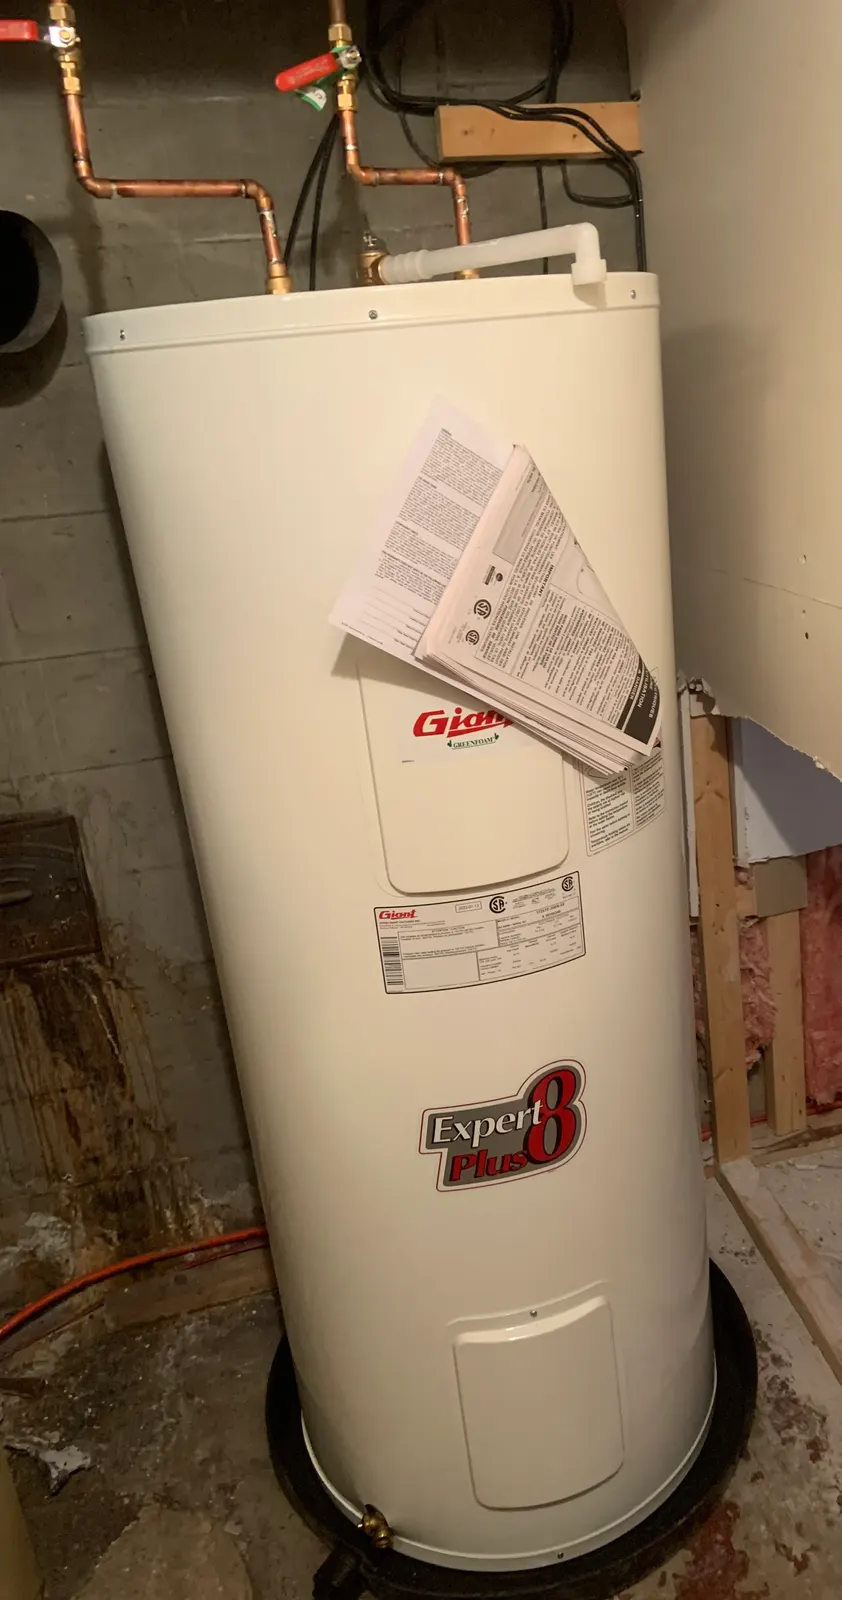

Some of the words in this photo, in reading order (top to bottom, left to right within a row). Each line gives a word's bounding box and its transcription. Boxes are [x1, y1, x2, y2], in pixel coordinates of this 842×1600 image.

[537, 564, 554, 596] IMPORTANT
[413, 707, 513, 738] Gian
[379, 910, 418, 920] Giant
[432, 1100, 543, 1148] Expert
[523, 1069, 576, 1164] 8
[449, 1149, 529, 1181] Plus
